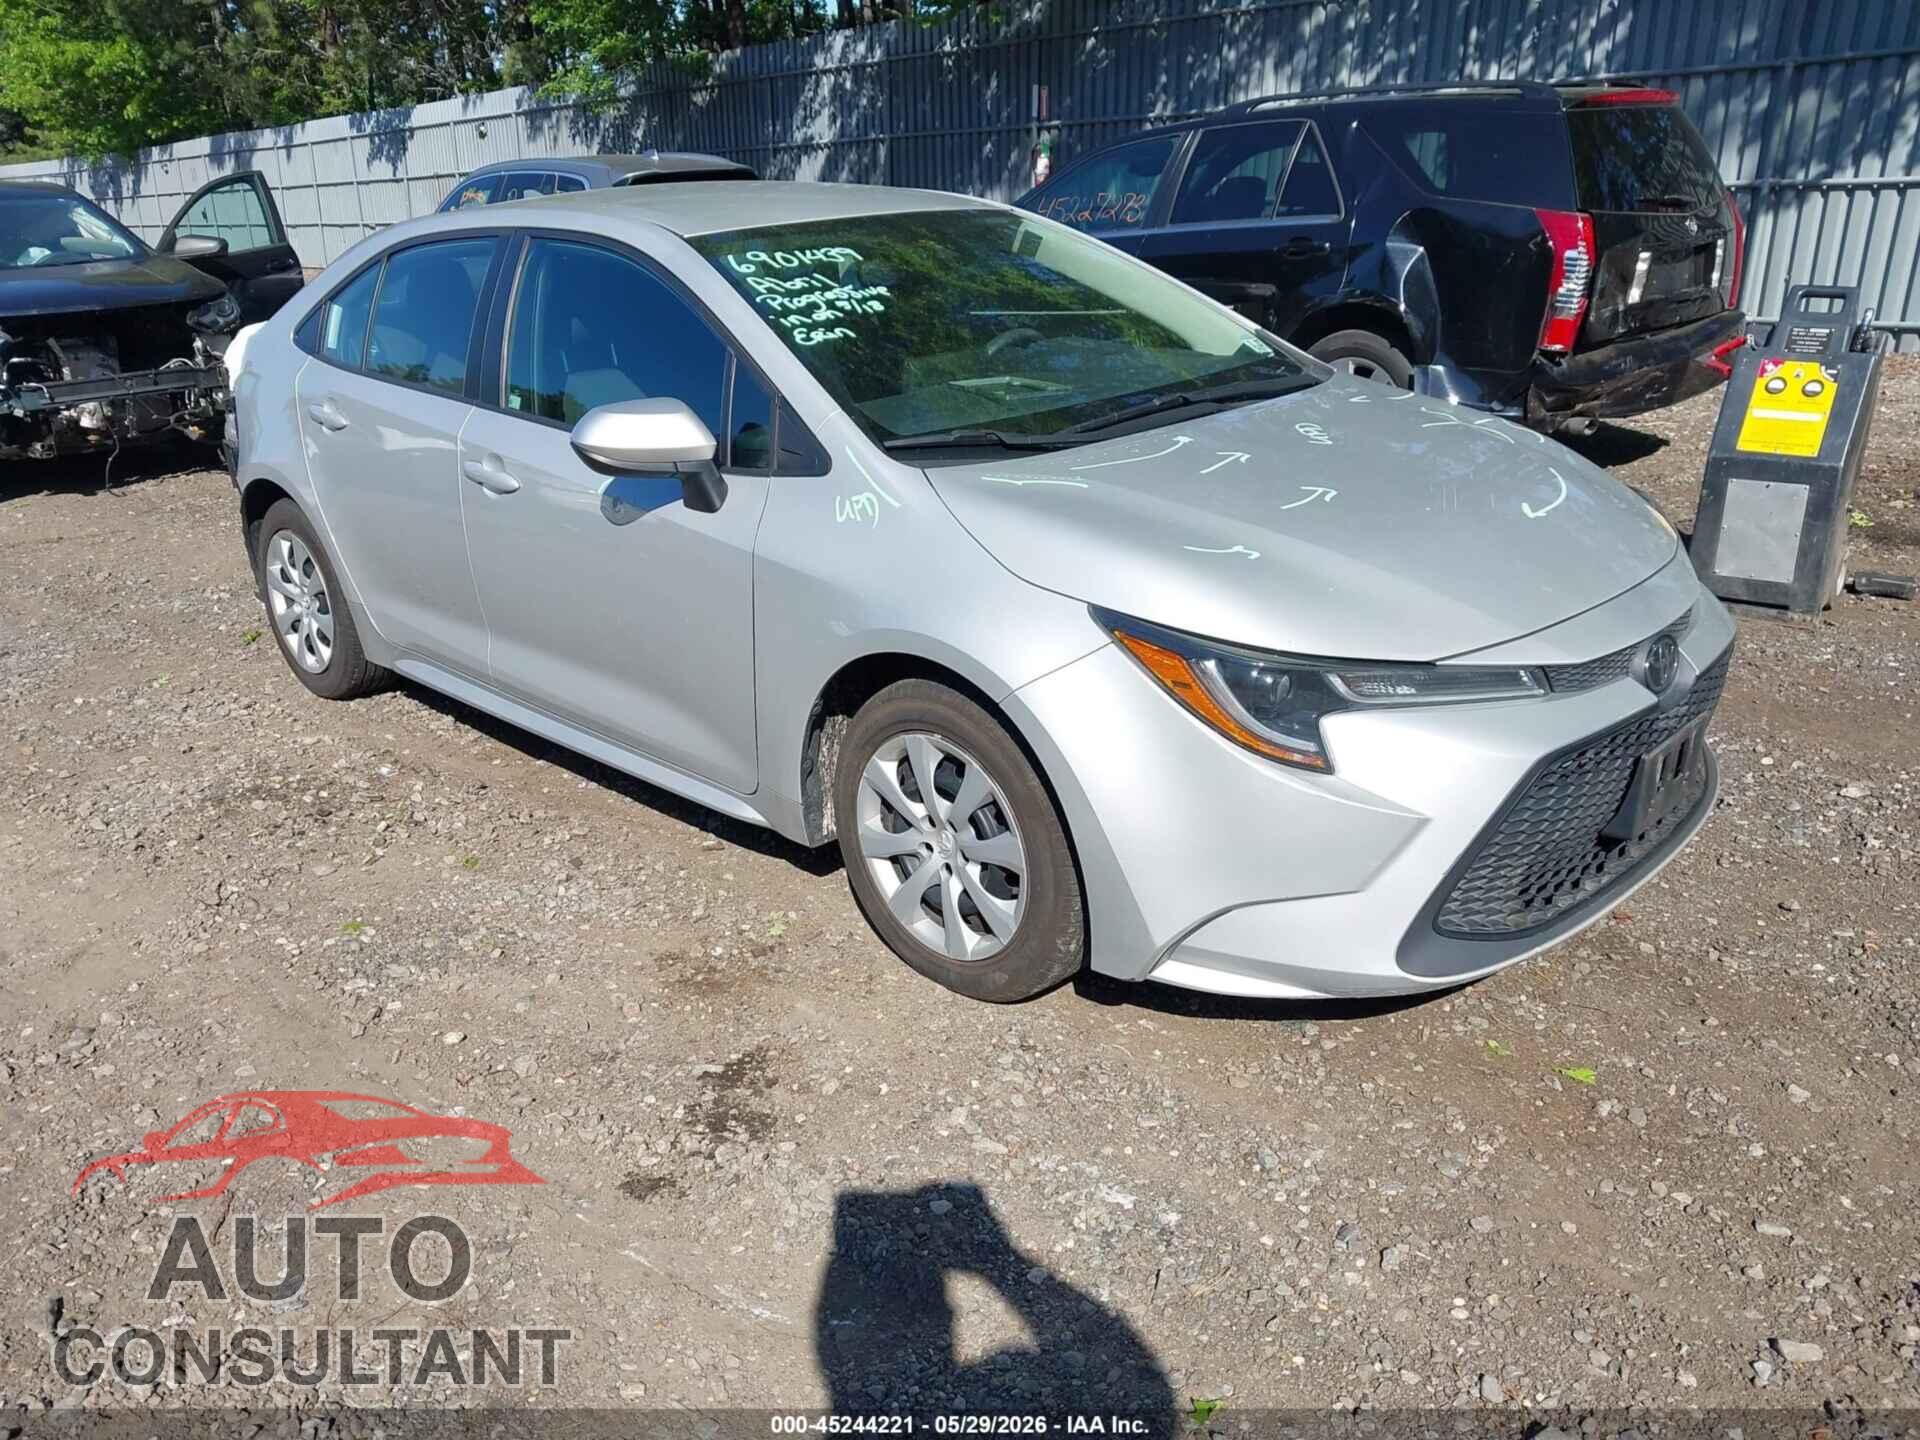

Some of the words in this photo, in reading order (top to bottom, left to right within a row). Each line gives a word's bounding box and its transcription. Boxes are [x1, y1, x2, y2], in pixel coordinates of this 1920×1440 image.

[728, 247, 864, 273] 6901439
[756, 284, 891, 313] Progressive
[811, 309, 844, 322] on
